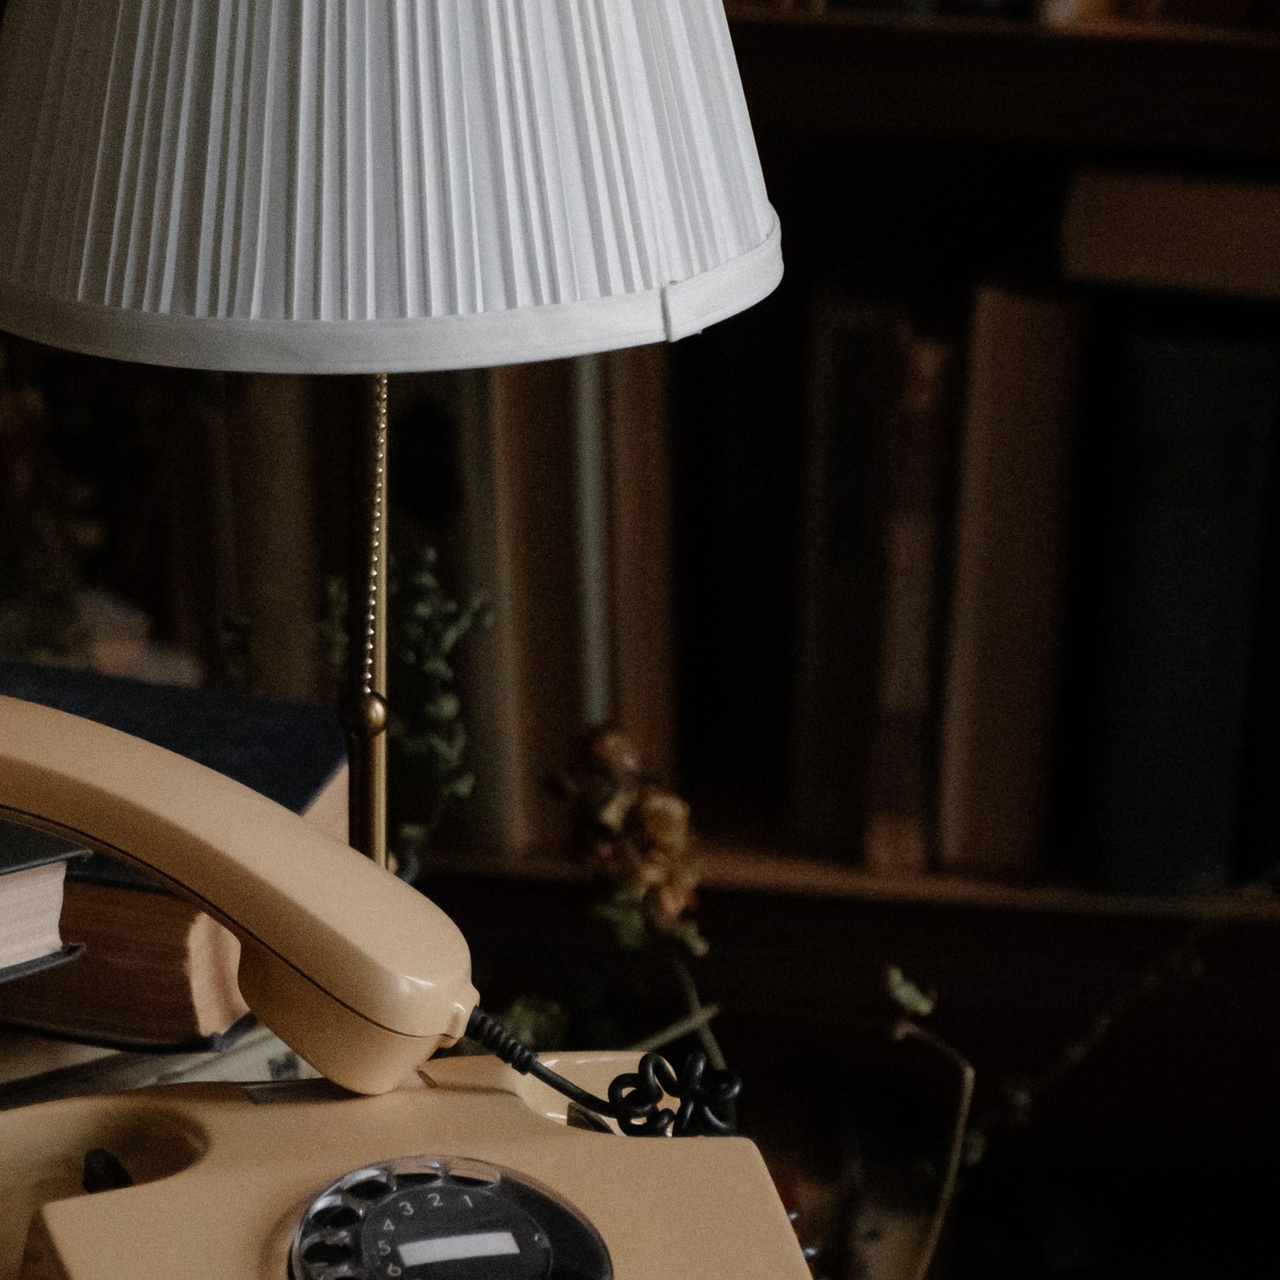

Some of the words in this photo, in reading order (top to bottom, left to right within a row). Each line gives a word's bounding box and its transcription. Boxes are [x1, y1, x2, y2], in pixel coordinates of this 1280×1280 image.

[427, 1193, 444, 1207] 2
[464, 1194, 474, 1208] 1
[398, 1201, 414, 1216] 3
[382, 1219, 395, 1231] 4
[378, 1240, 391, 1256] 5
[387, 1263, 402, 1277] 6
